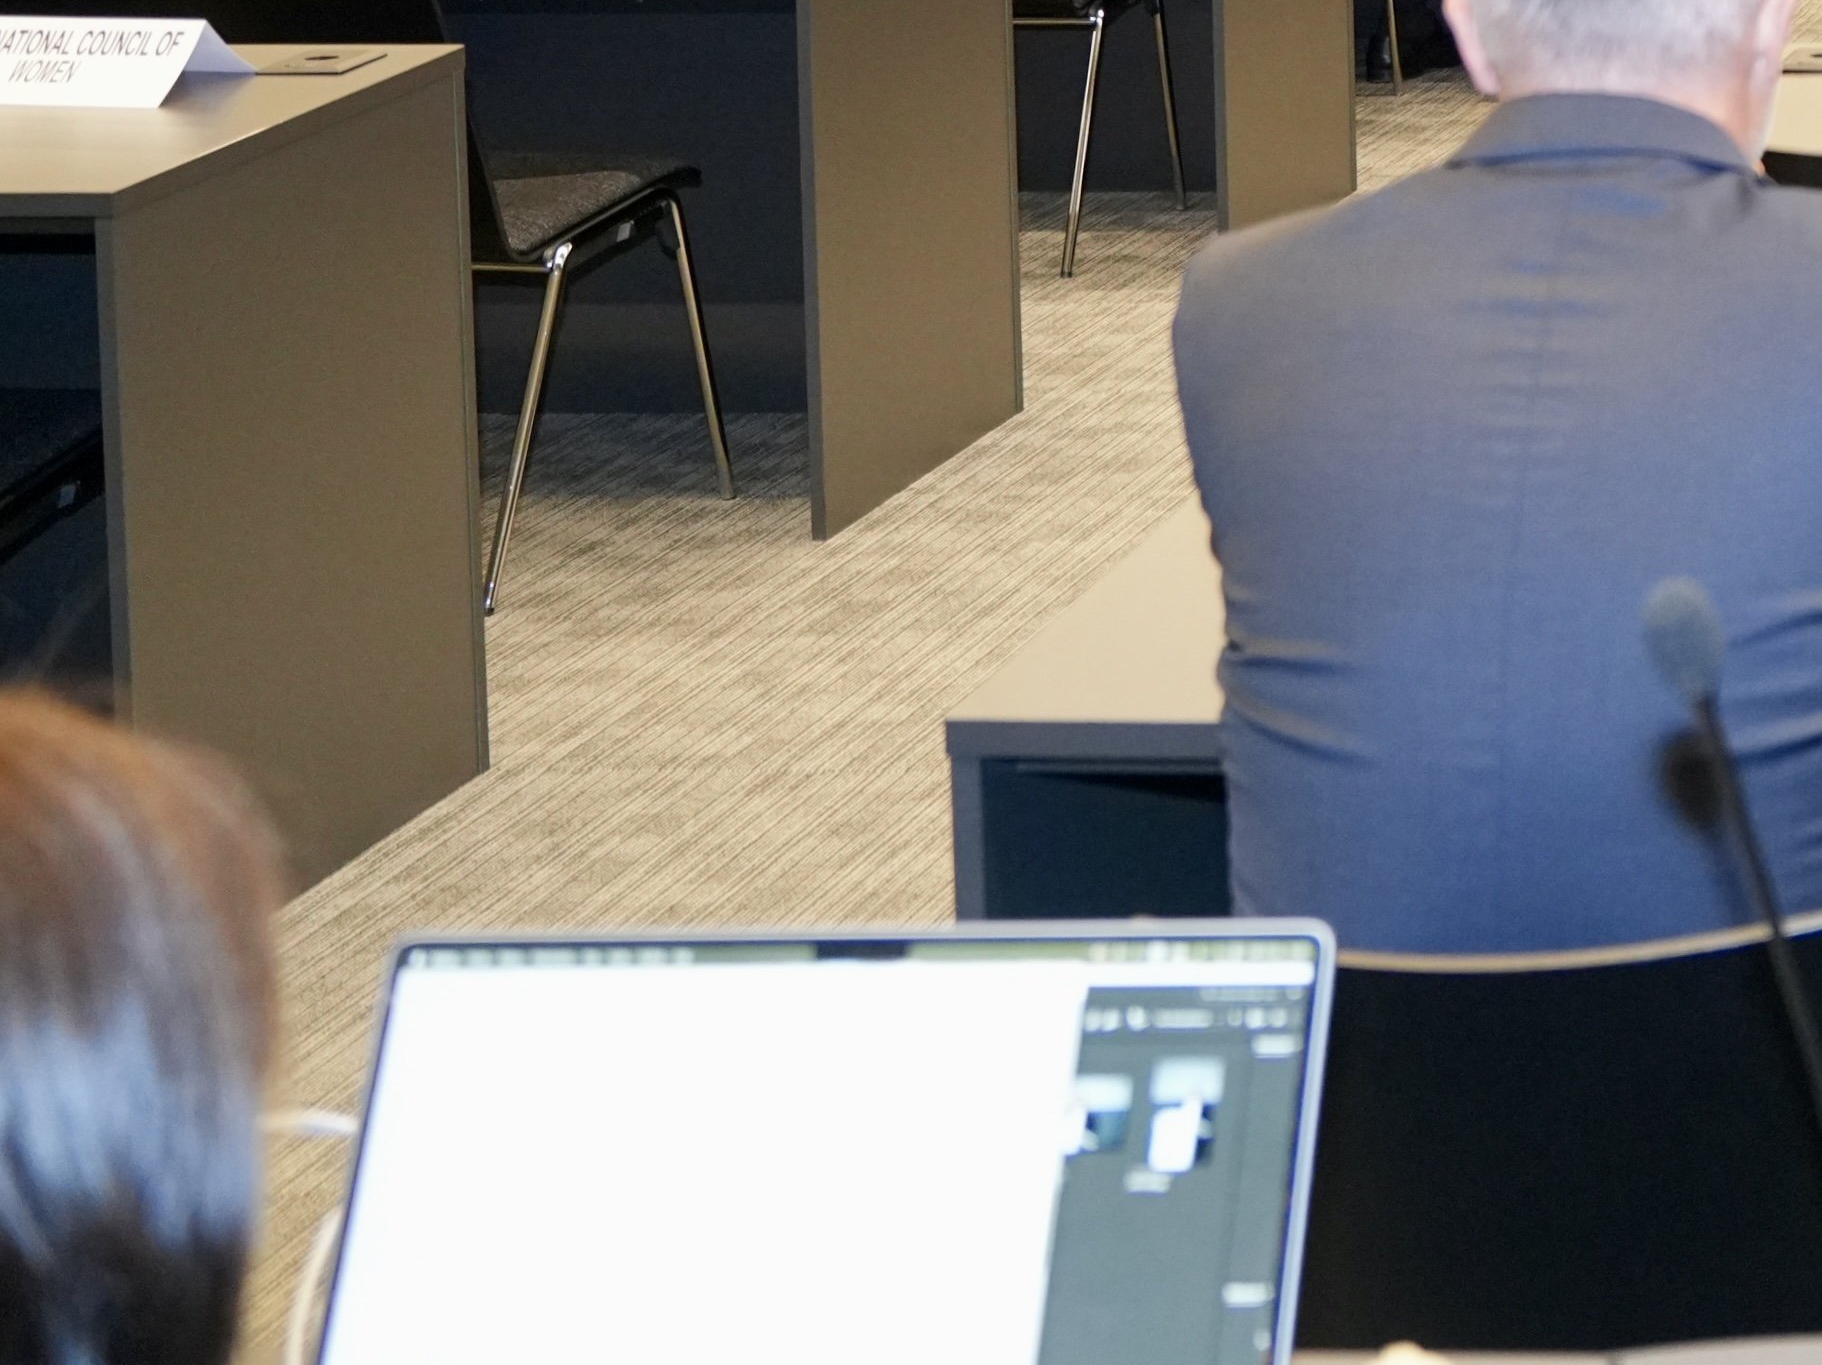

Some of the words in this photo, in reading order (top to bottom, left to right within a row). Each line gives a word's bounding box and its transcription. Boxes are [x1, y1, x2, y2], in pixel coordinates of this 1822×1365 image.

[76, 30, 152, 56] COUNCIL
[155, 31, 184, 56] OF
[8, 60, 81, 83] WOMEN
